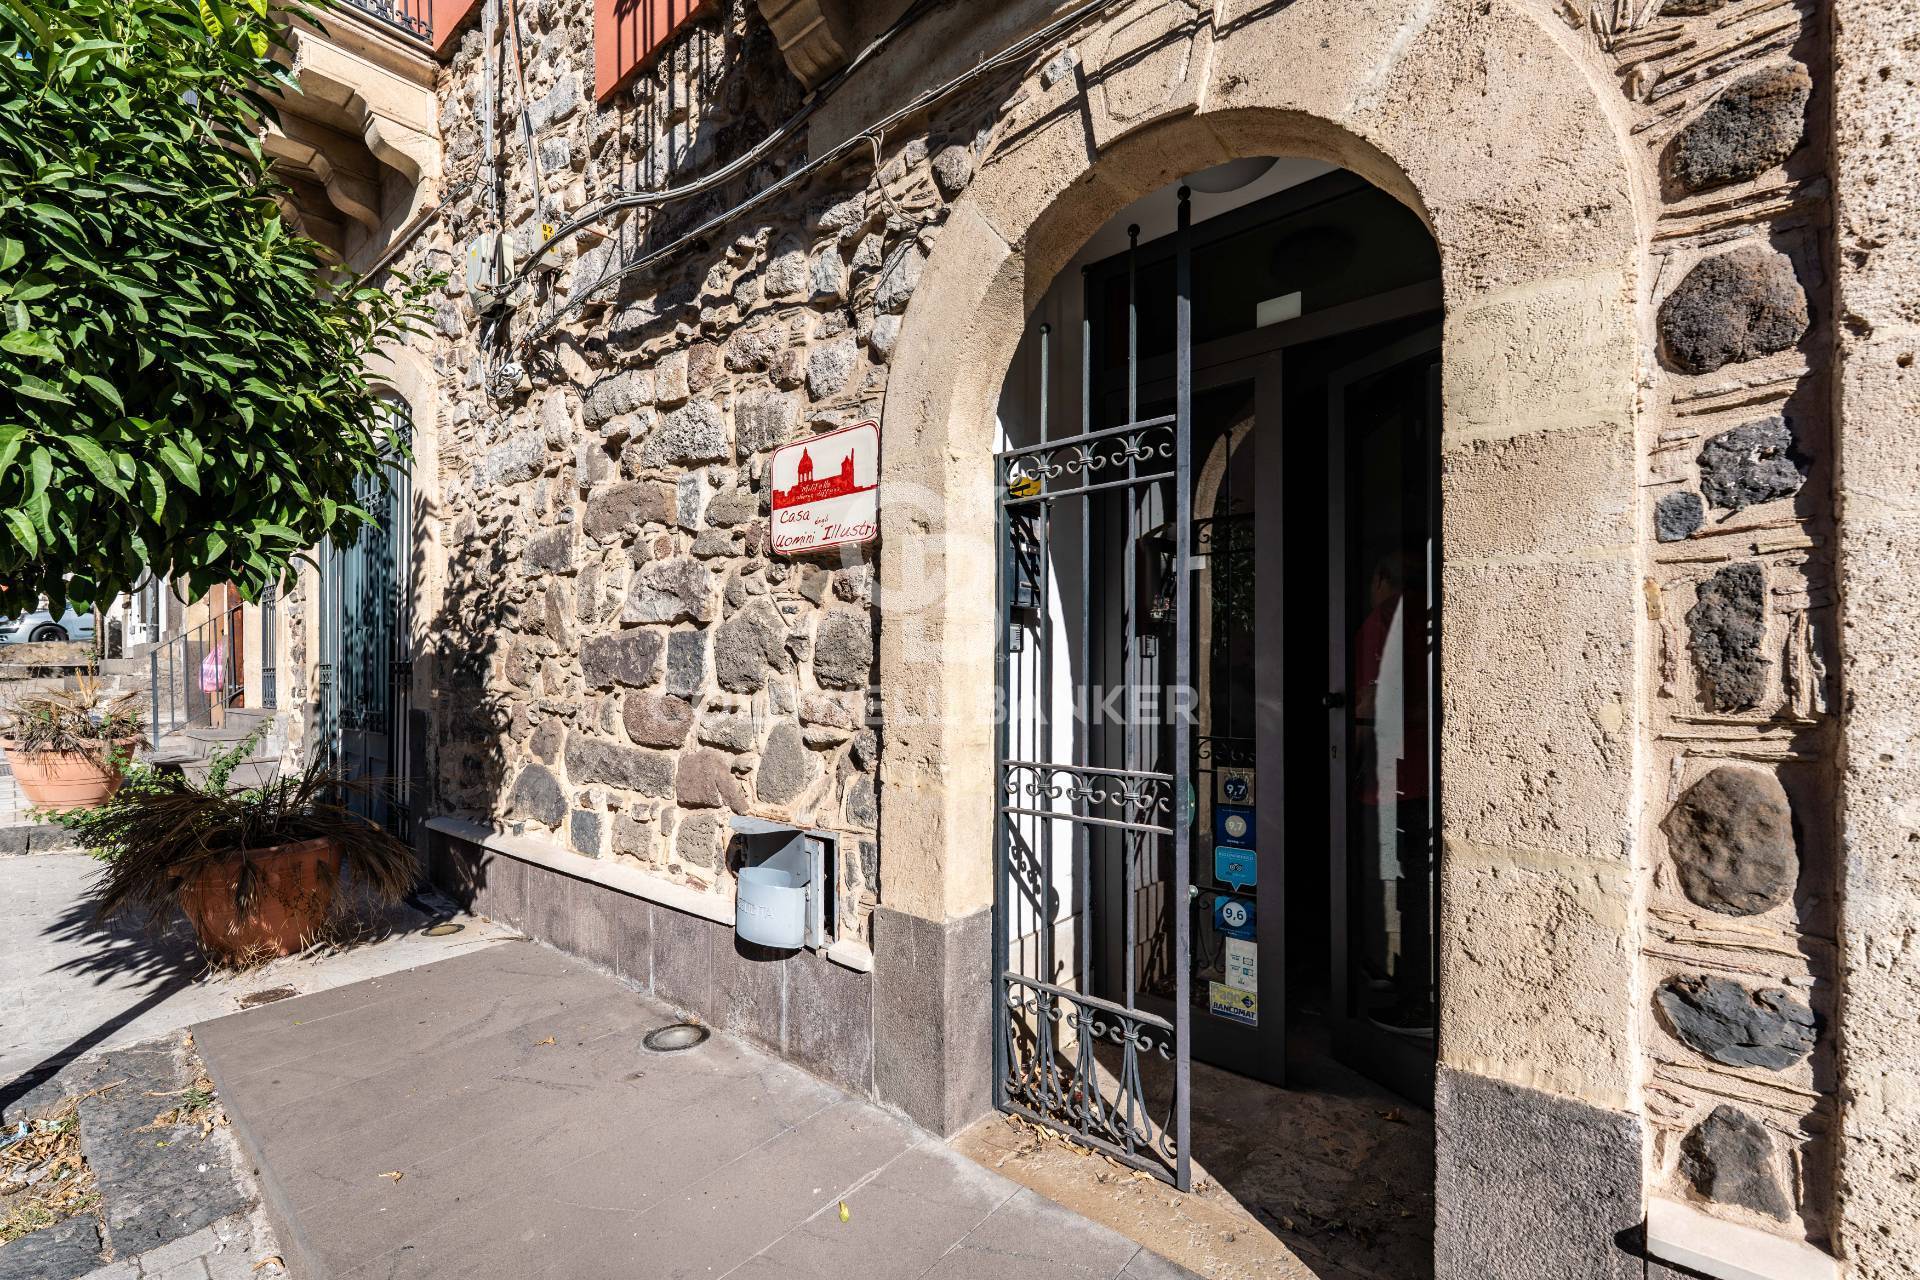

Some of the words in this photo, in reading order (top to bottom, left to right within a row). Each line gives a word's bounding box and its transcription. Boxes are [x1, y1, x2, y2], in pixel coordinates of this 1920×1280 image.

[780, 510, 810, 523] Casa
[776, 531, 815, 547] Uomini
[822, 520, 877, 541] Illustri
[1225, 907, 1244, 920] 9,6
[1213, 1001, 1256, 1019] BANCOMAT
